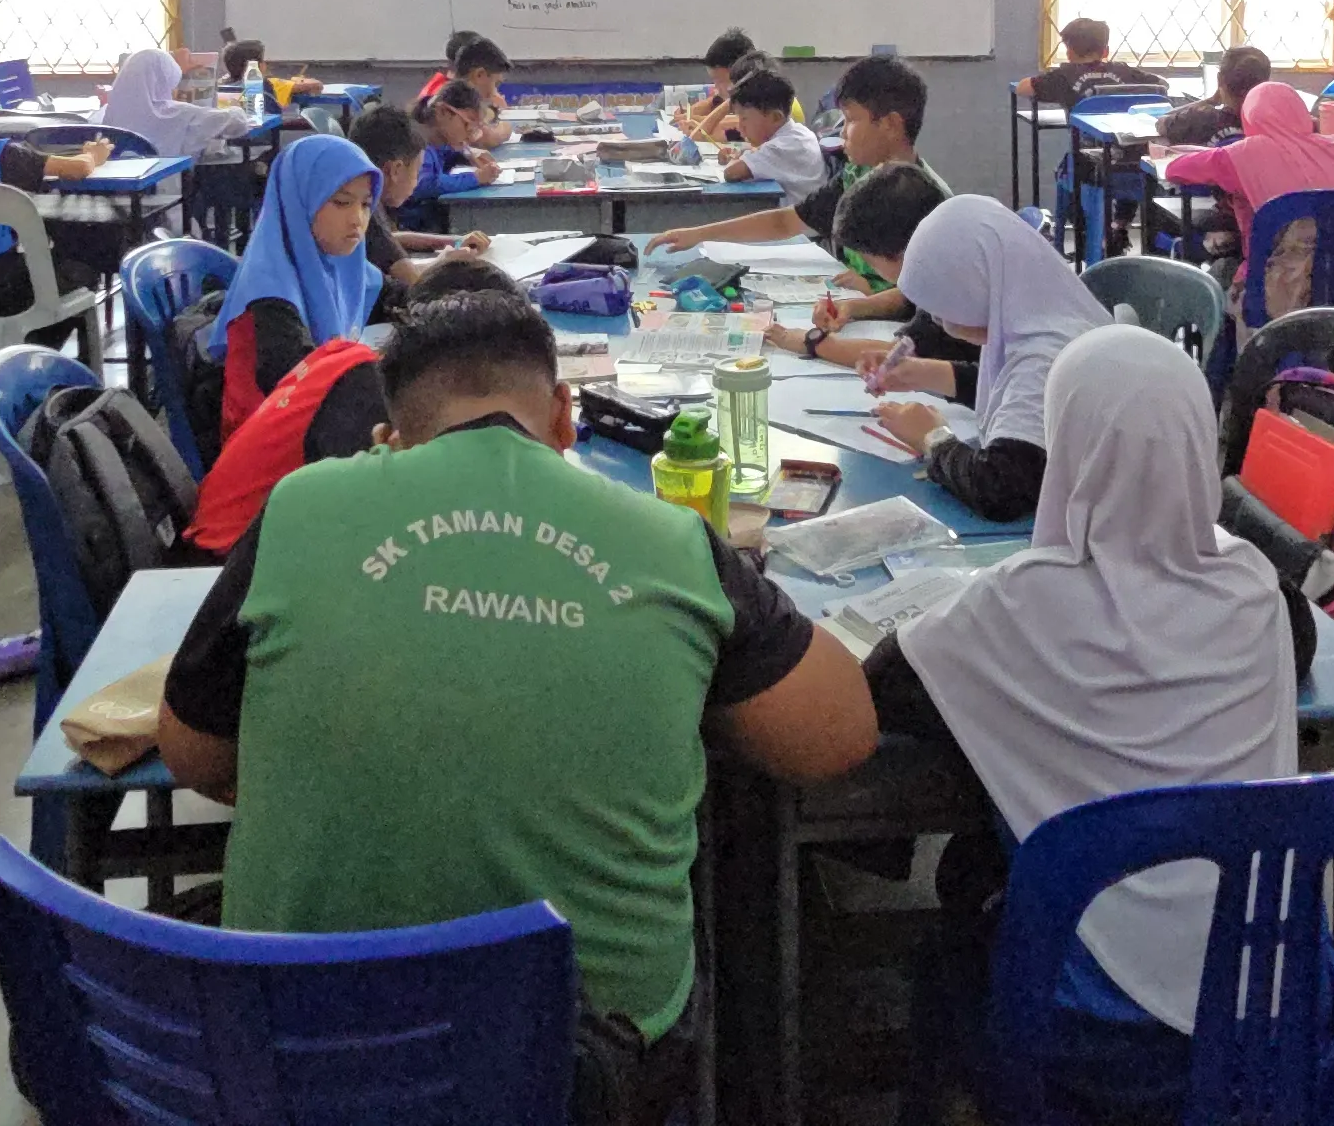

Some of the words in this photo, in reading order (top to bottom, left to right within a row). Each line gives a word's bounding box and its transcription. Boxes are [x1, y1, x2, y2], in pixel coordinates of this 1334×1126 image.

[361, 536, 410, 581] SK
[406, 509, 523, 545] TAMAN
[535, 521, 611, 584] DESA
[608, 584, 634, 606] 2
[424, 585, 586, 629] RAWANG
